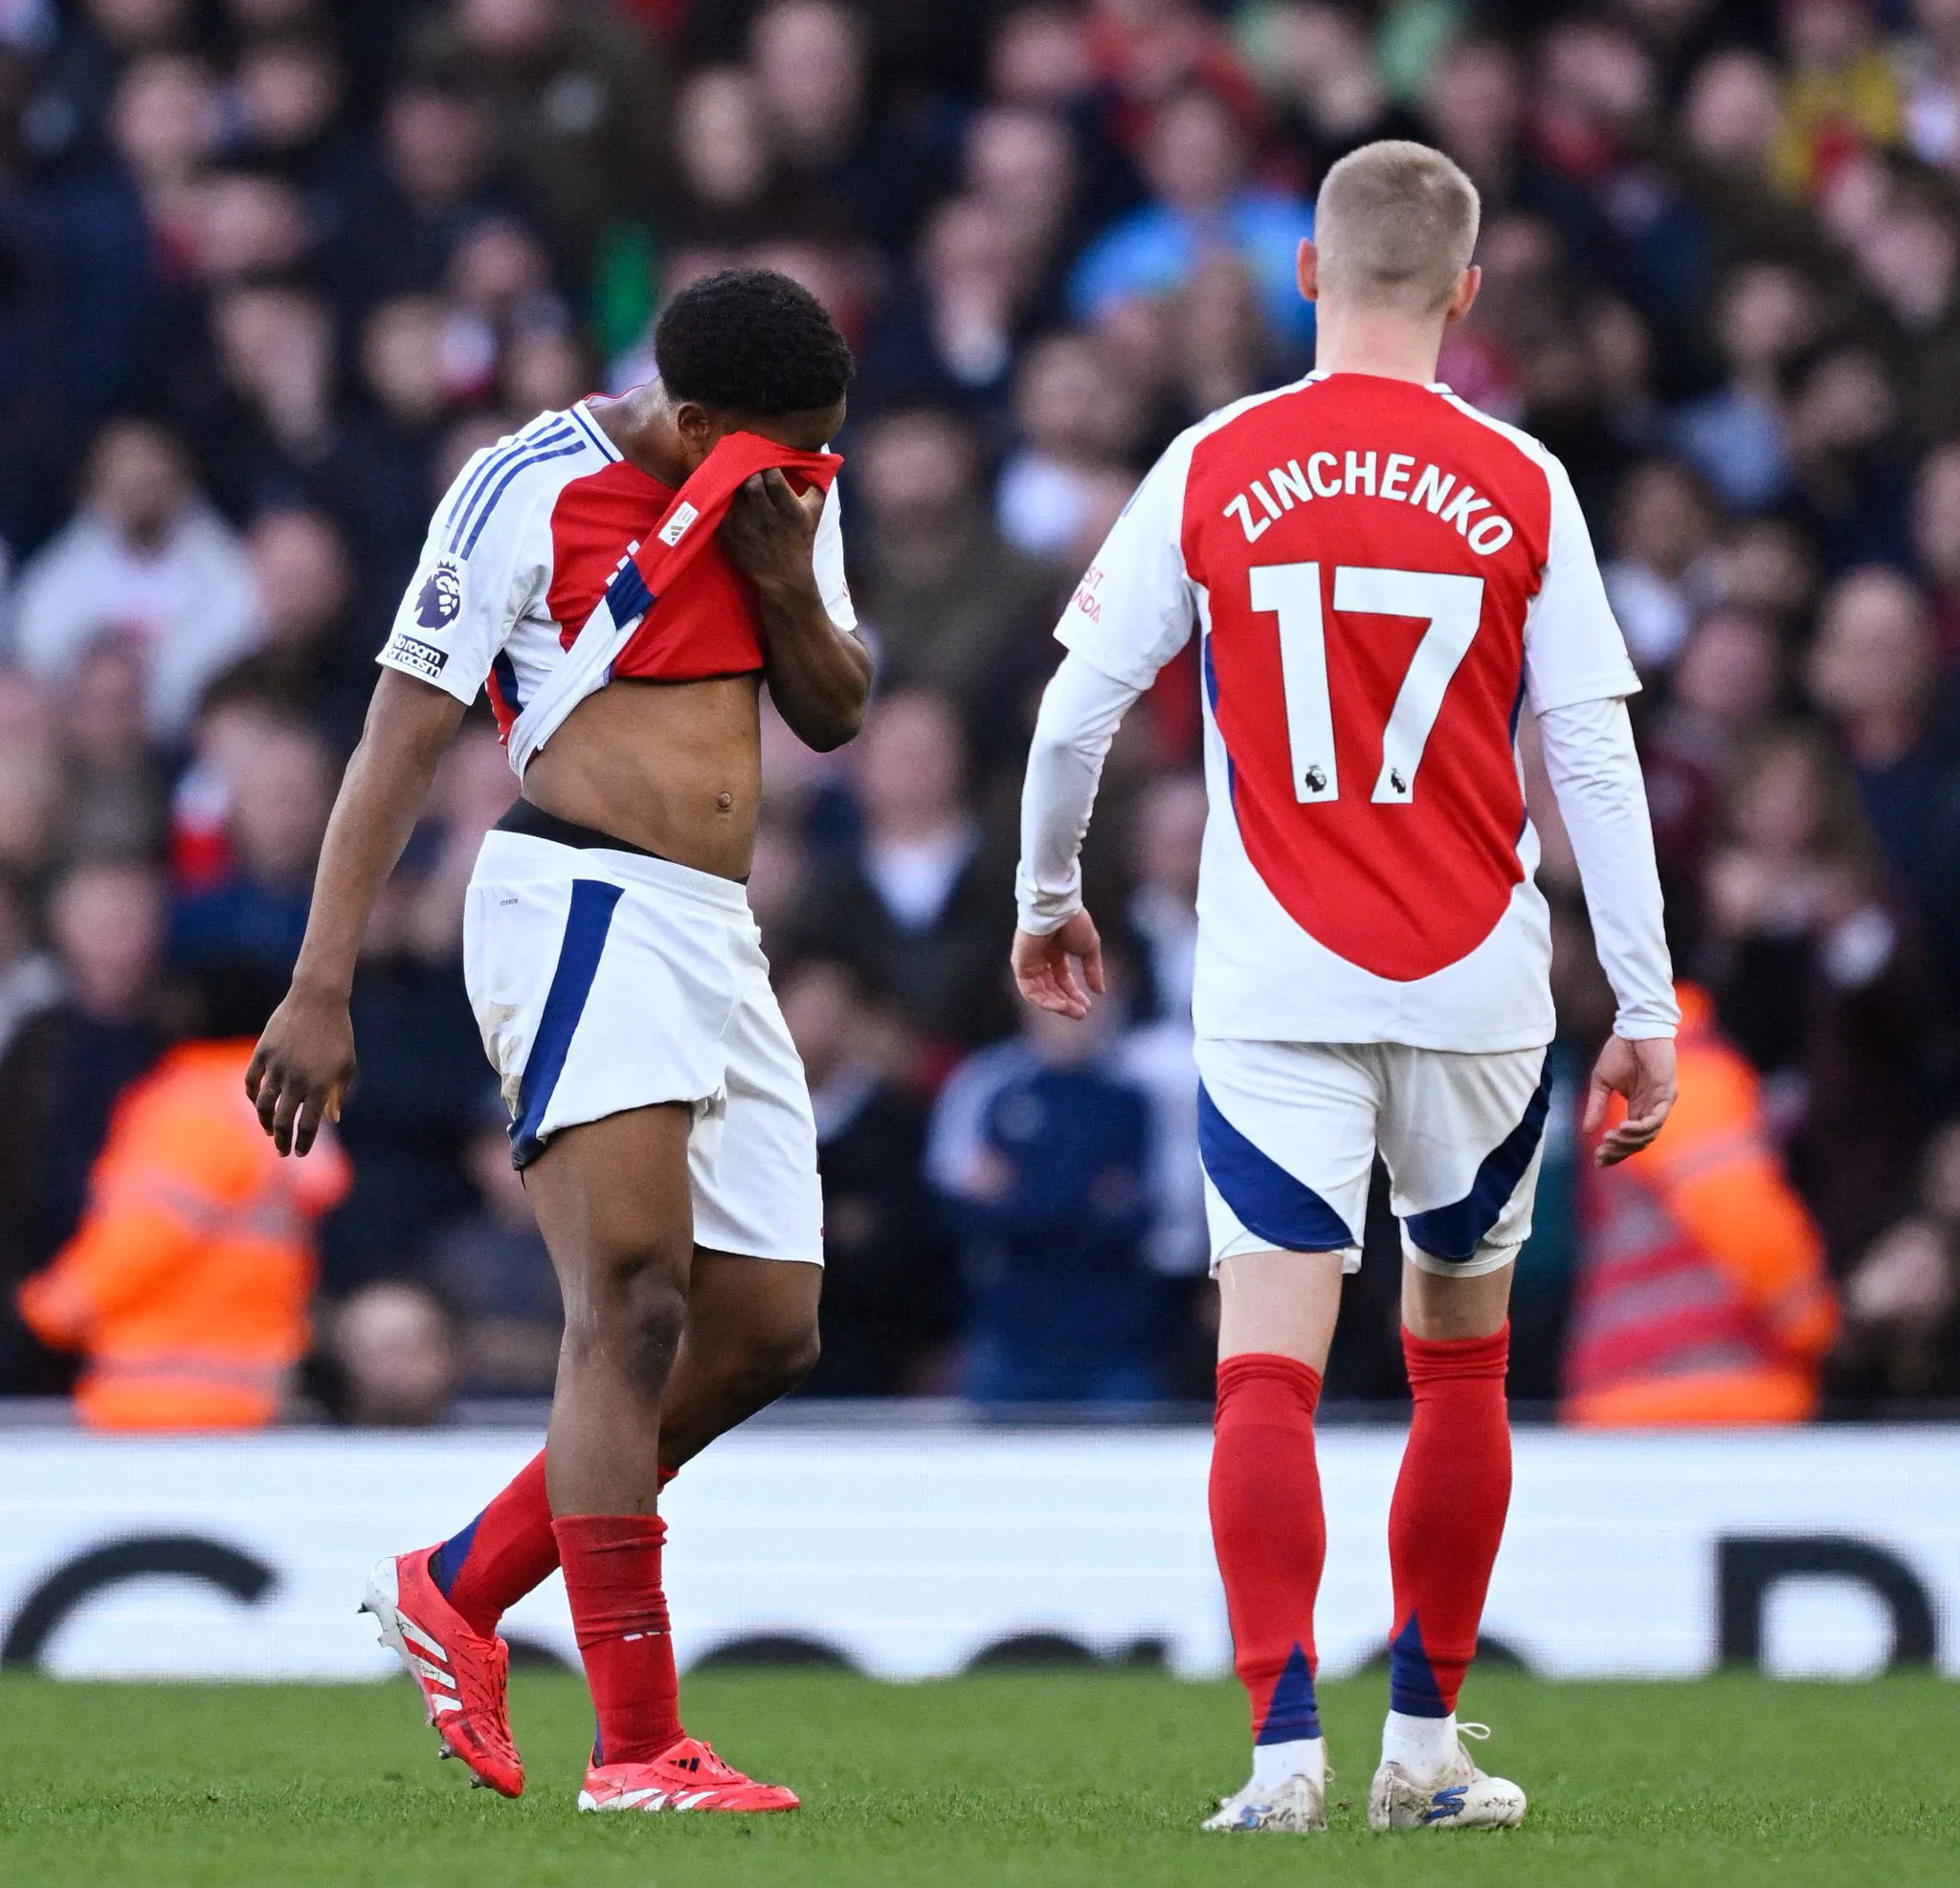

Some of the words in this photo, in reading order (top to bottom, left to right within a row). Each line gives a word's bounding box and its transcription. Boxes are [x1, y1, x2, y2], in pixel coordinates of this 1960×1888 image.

[1222, 450, 1514, 556] ZINCHENKO
[1072, 587, 1102, 624] NDA
[404, 639, 441, 665] room
[1248, 561, 1485, 805] 17
